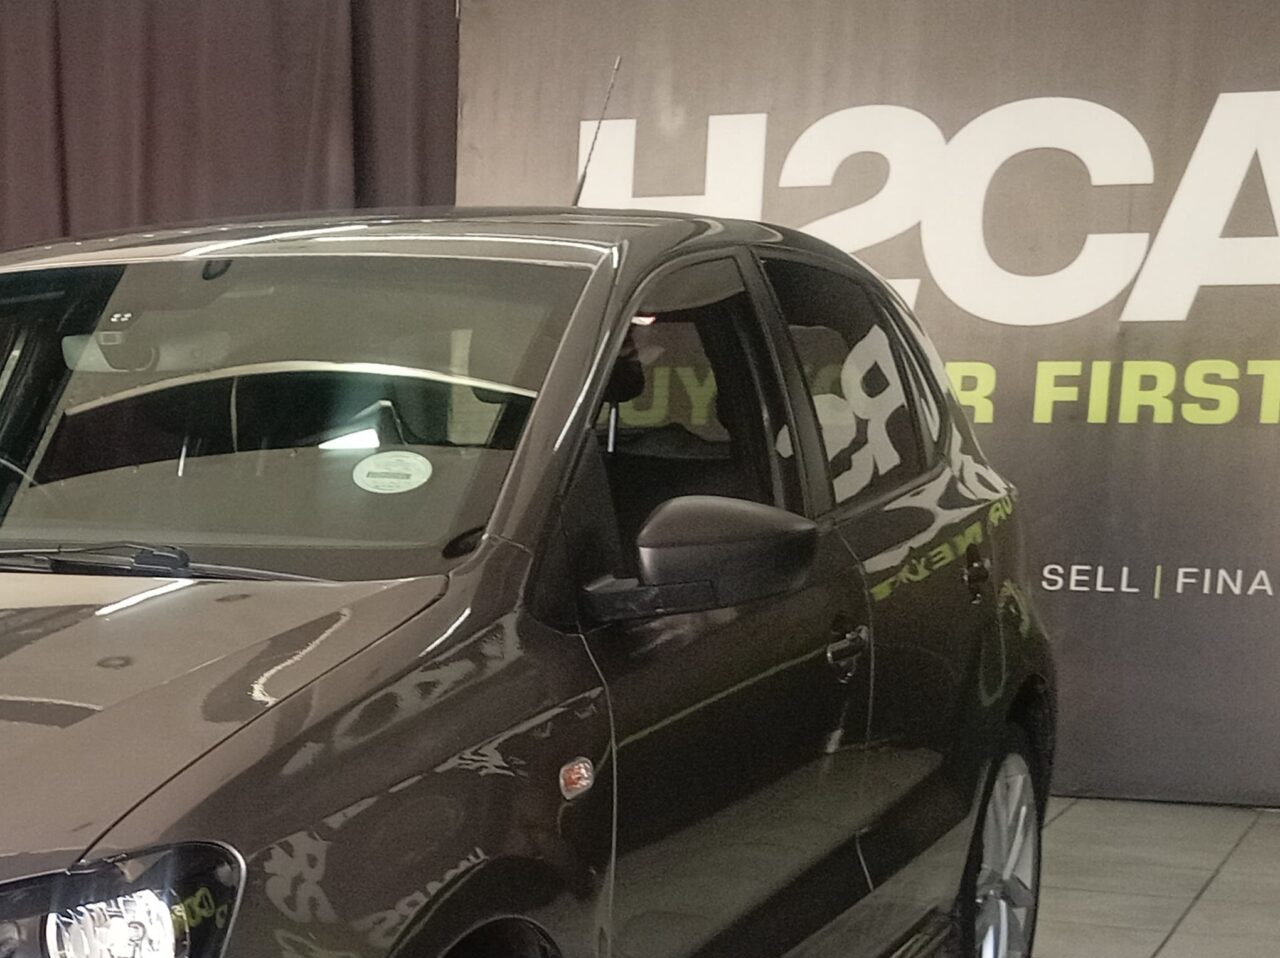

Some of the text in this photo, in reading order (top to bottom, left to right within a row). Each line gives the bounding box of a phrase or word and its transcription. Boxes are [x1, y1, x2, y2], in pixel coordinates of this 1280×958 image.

[1033, 359, 1280, 425] FIRST
[1041, 564, 1274, 596] SELL FINA
